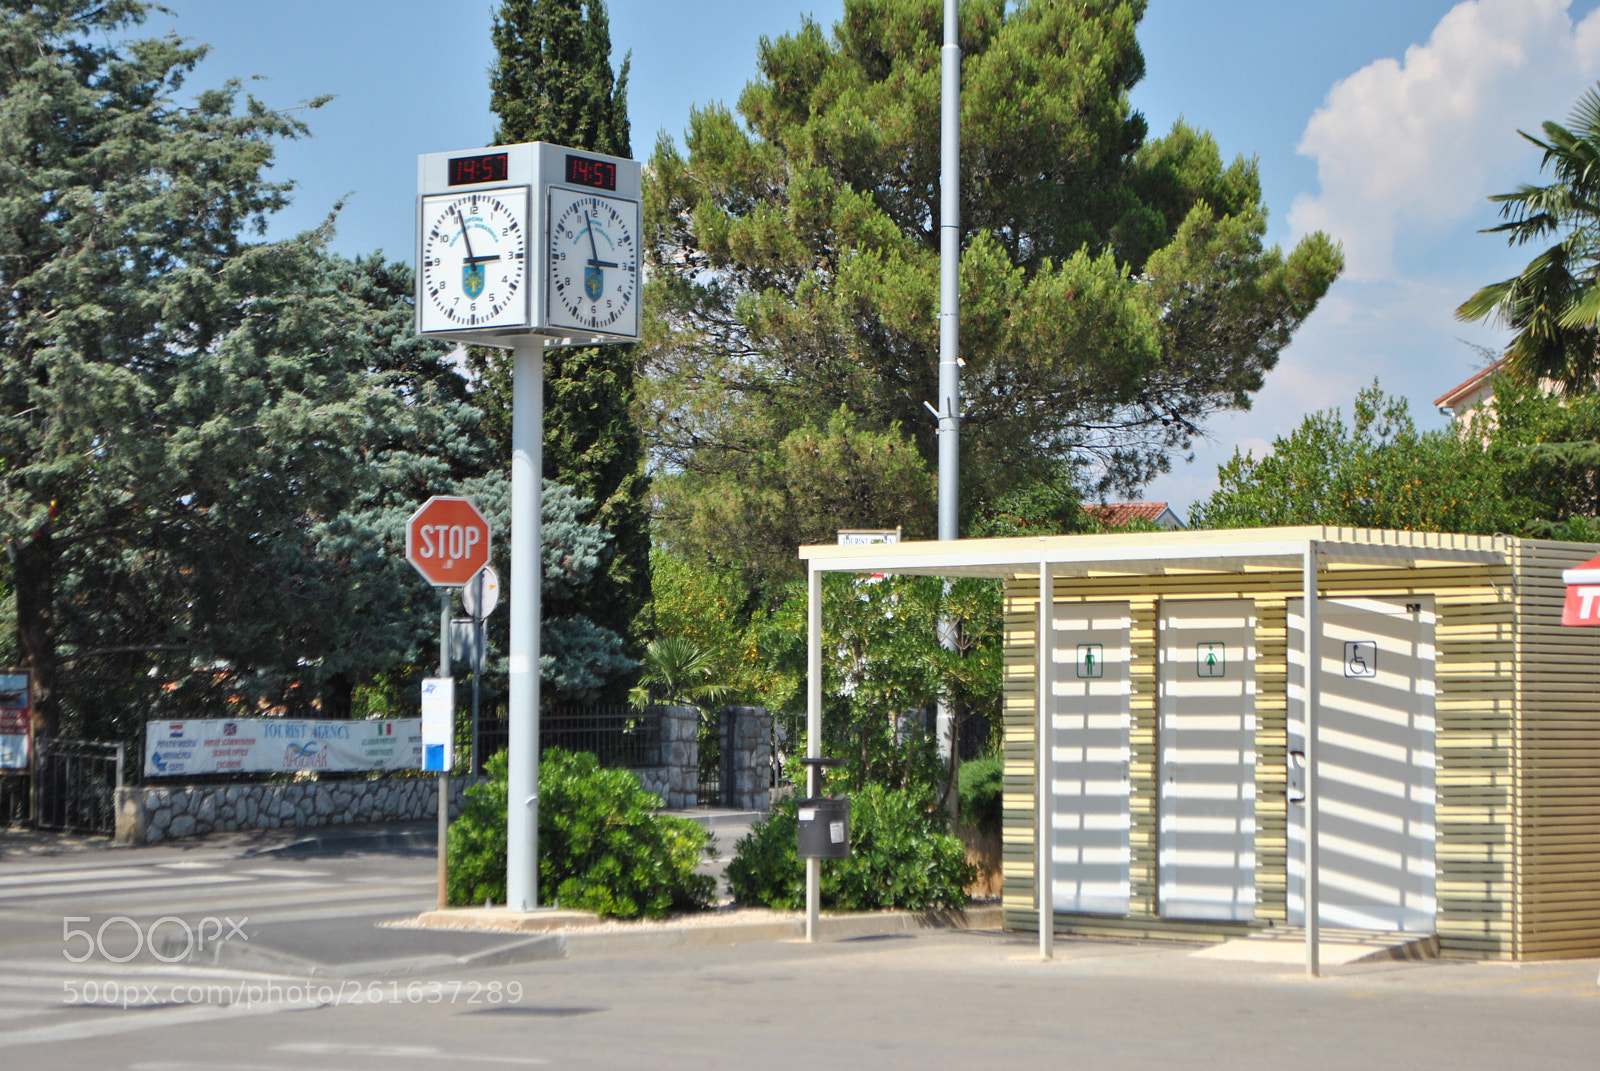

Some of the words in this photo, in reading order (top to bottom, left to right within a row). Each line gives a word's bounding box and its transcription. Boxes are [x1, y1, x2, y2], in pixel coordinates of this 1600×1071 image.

[457, 155, 506, 181] 14:57
[572, 160, 615, 186] 14:57
[420, 524, 479, 559] STOP
[1577, 587, 1600, 619] T
[263, 723, 307, 739] TOURIST
[311, 724, 350, 740] AGENCY
